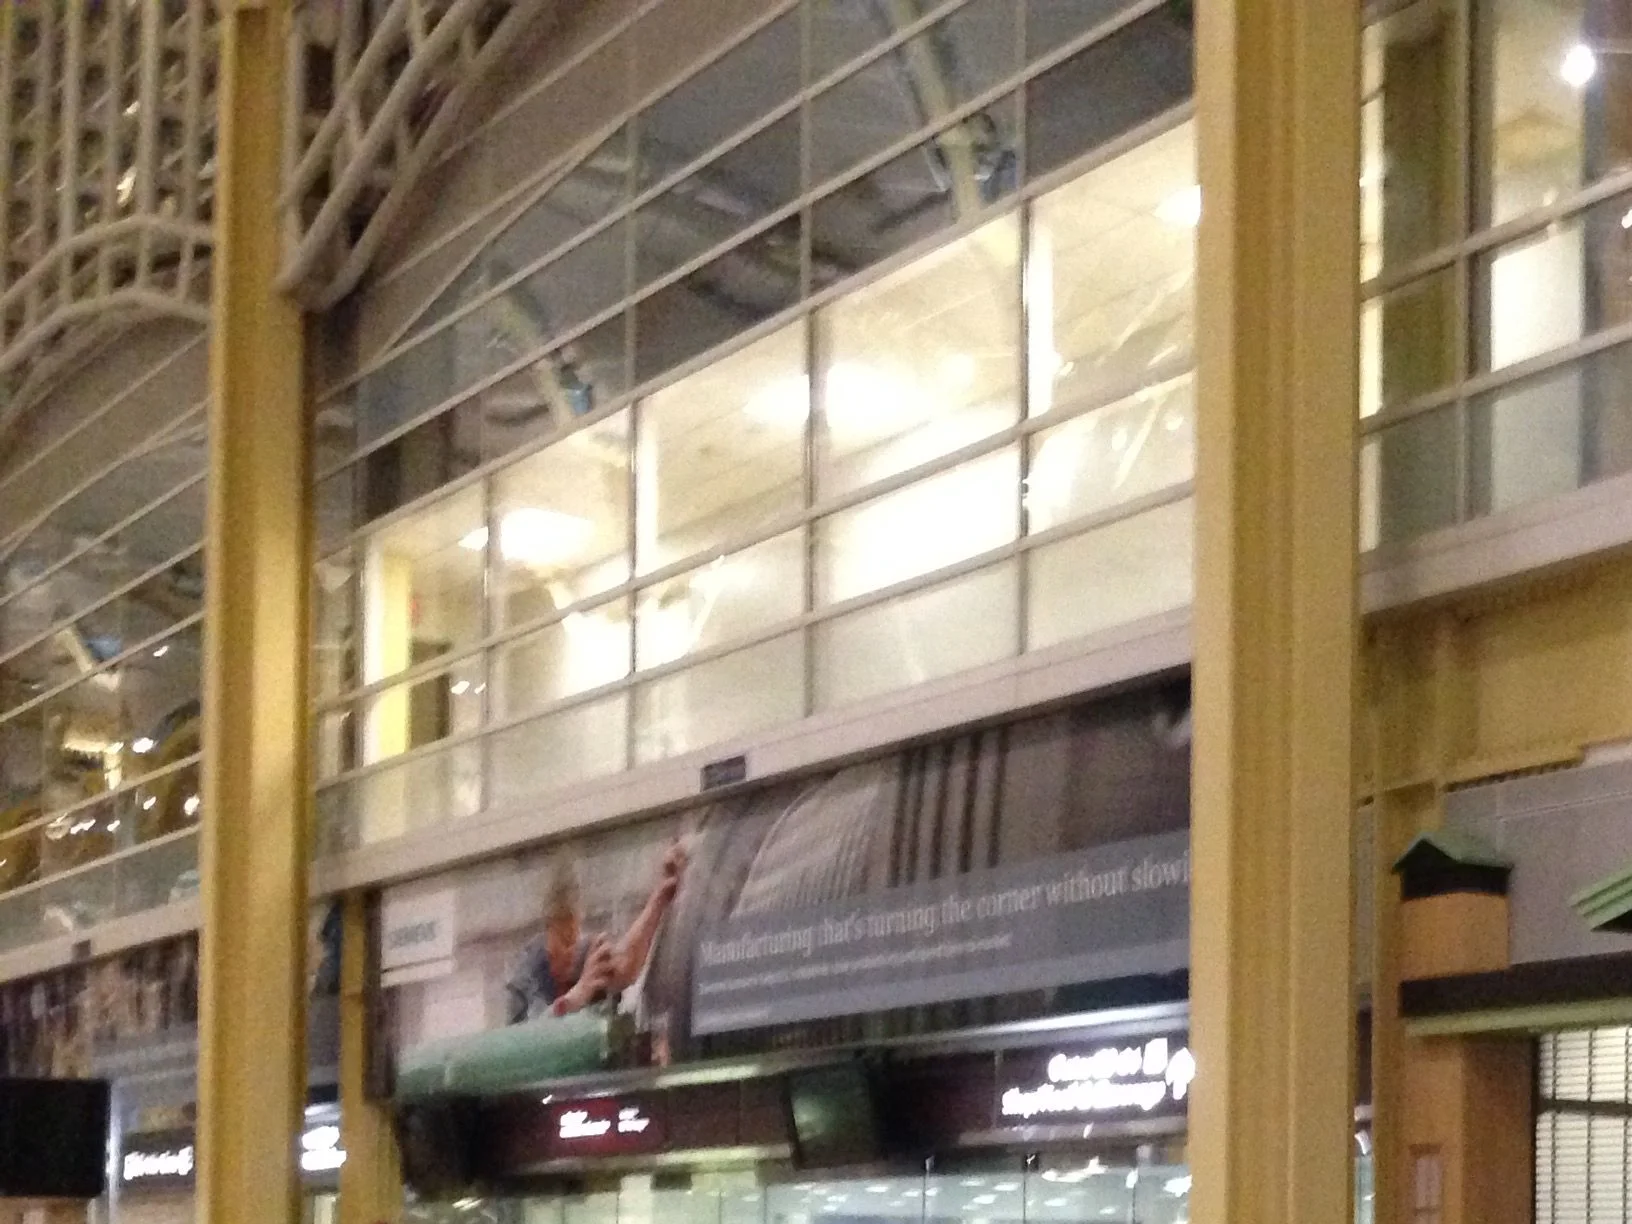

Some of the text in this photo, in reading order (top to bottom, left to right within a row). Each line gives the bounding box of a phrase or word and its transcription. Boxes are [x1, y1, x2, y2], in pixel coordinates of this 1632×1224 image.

[701, 926, 813, 968] Manufacturing
[941, 892, 971, 924] the
[976, 884, 1041, 919] corner
[1046, 866, 1130, 906] without
